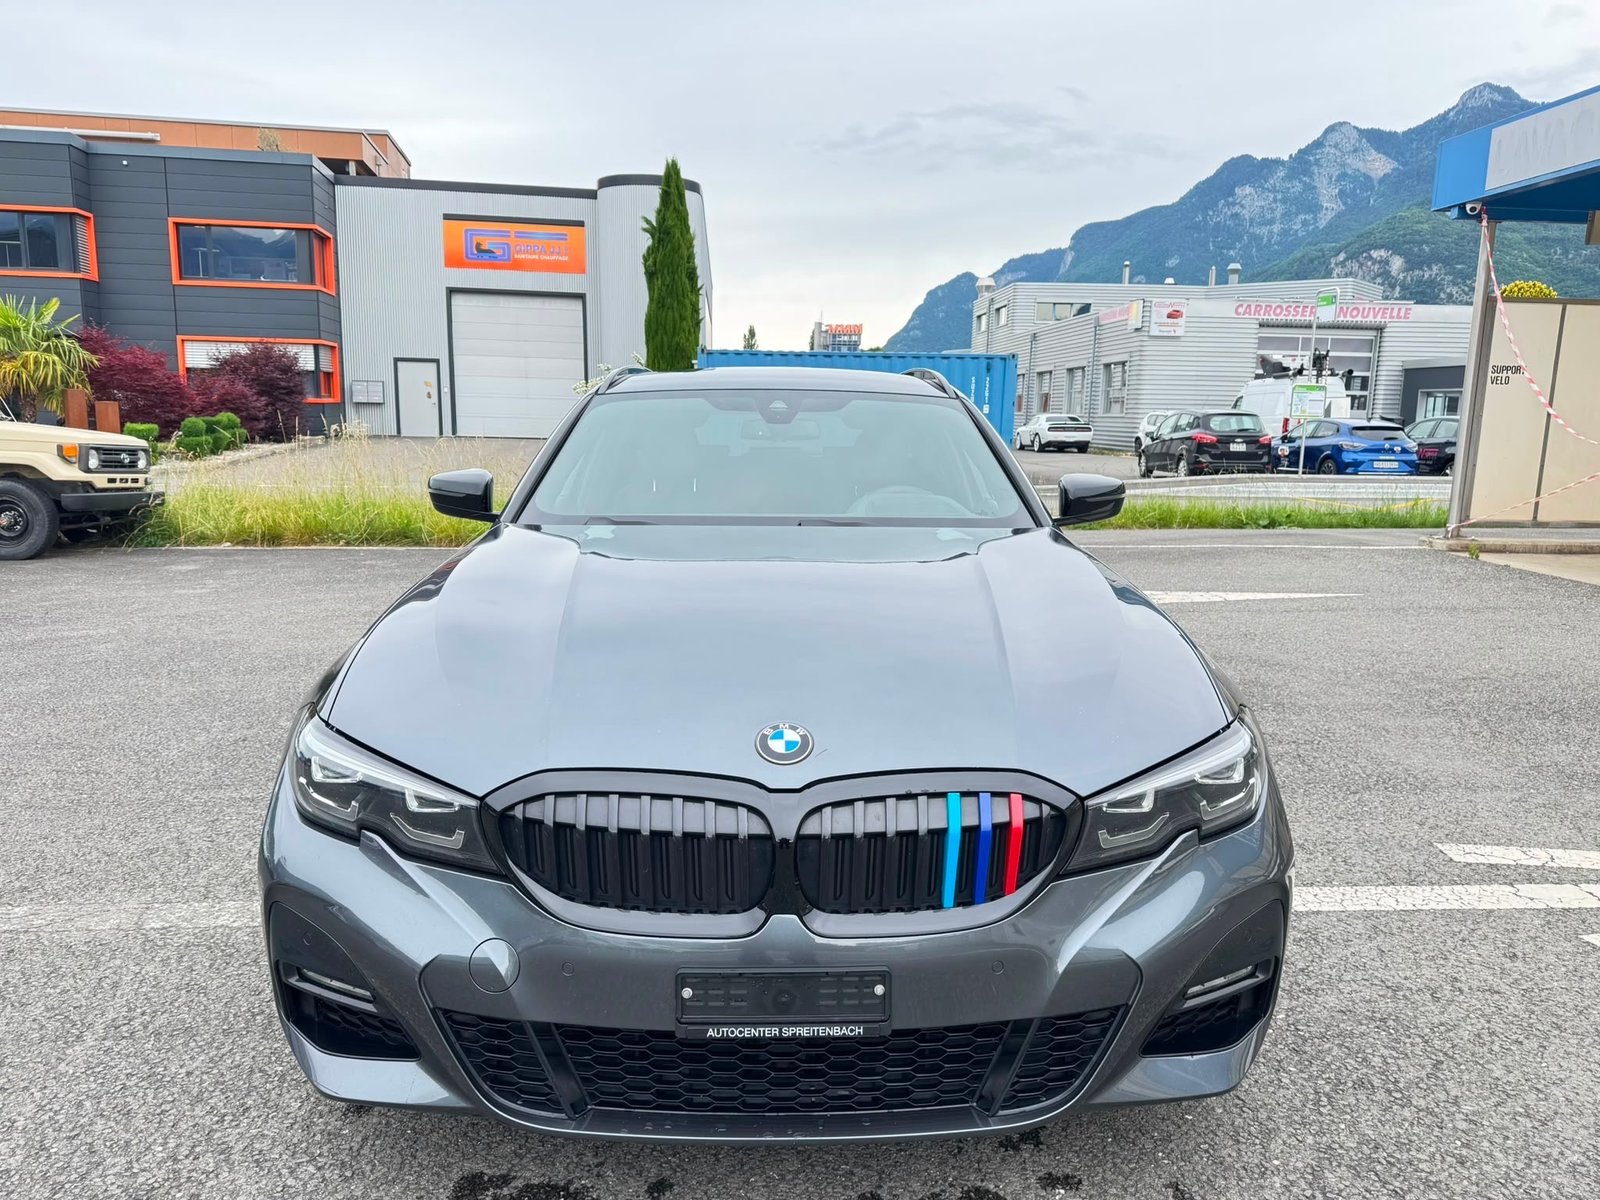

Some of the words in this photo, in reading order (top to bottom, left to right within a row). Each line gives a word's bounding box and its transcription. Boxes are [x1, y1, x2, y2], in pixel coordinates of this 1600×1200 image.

[1234, 303, 1317, 318] CARROSSER
[1337, 306, 1412, 320] NOUVELLE
[1490, 375, 1510, 385] VELO
[763, 723, 806, 735] BMW
[706, 1027, 779, 1038] AUTOCENTER
[781, 1026, 864, 1037] SPREITENBACH
